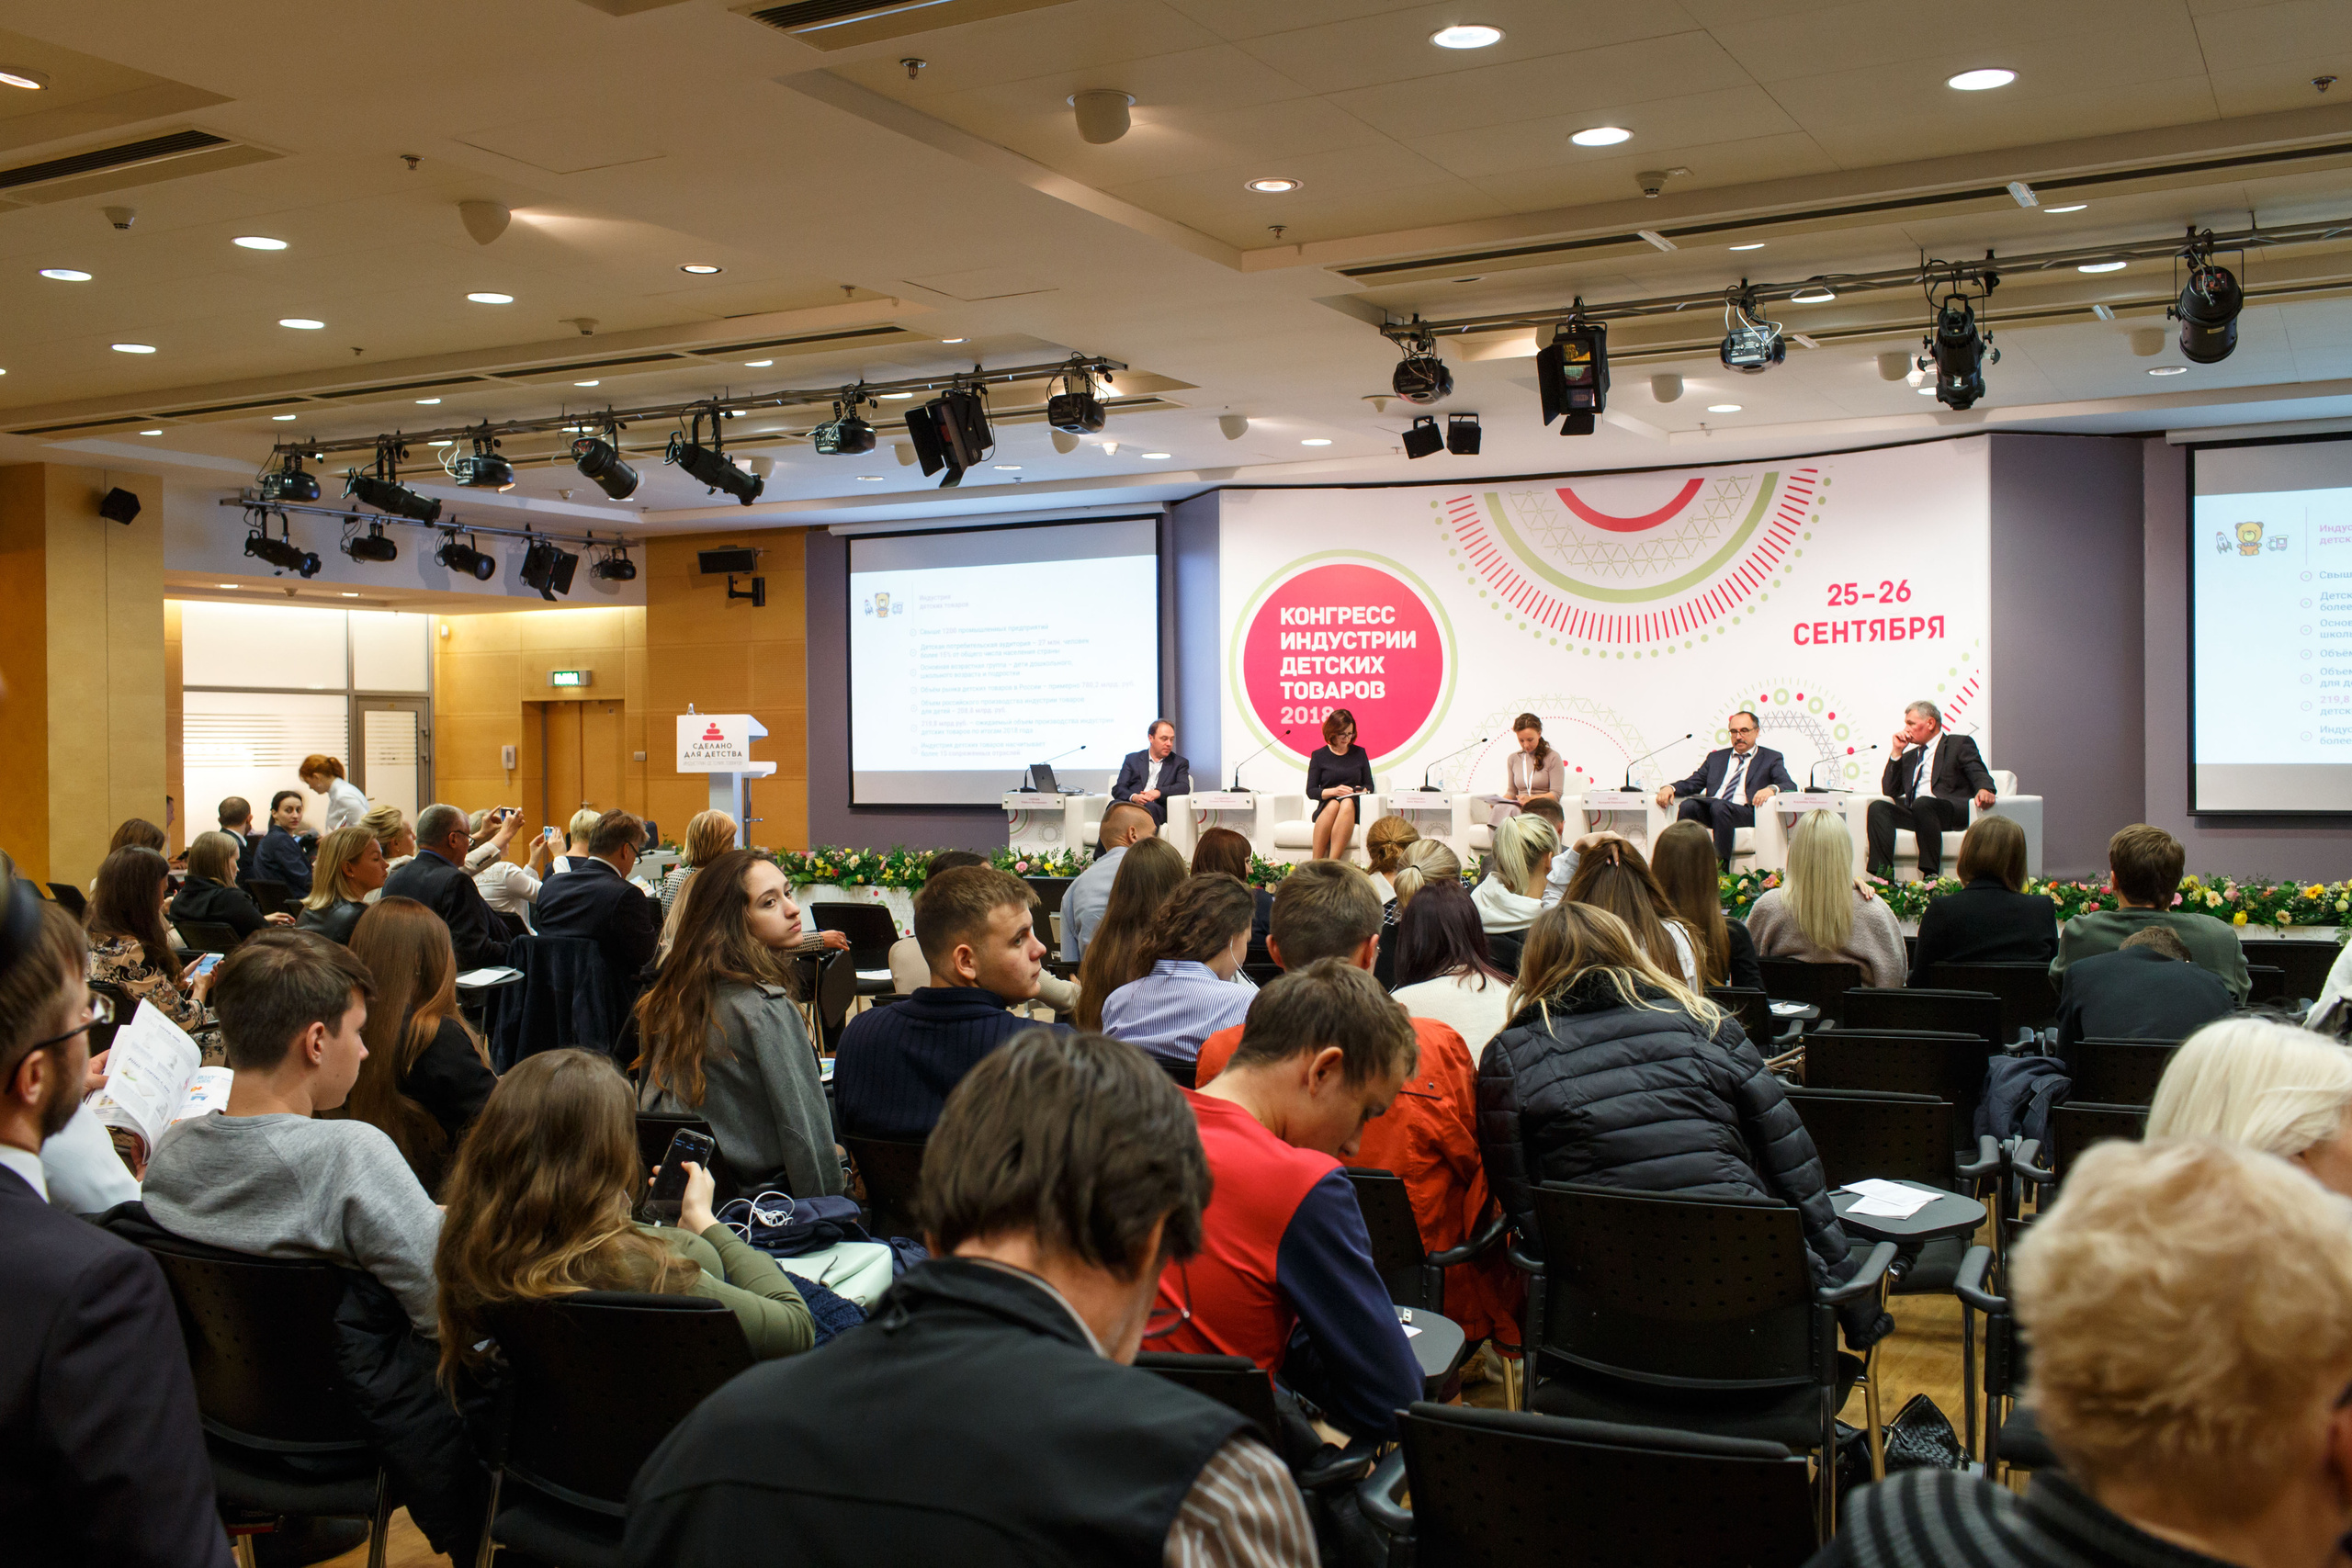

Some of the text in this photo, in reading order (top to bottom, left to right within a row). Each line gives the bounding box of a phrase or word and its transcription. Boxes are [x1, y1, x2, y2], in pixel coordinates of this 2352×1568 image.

[2320, 525, 2352, 533] Индус
[2320, 536, 2352, 546] детск
[2320, 592, 2352, 601] Детск
[1281, 606, 1395, 625] КОНГРЕСС
[1793, 615, 1944, 645] СЕНТЯБРЯ
[1281, 630, 1416, 651] ИНДУСТРИИ
[1280, 656, 1385, 676] ДЕТСКИХ
[2320, 680, 2352, 688] для д
[1280, 681, 1385, 699] ТОВАРОВ
[2320, 695, 2349, 705] 219,8
[1281, 706, 1335, 724] 2018
[2320, 708, 2352, 716] детск
[2320, 726, 2352, 735] Индус
[2320, 737, 2352, 745] более
